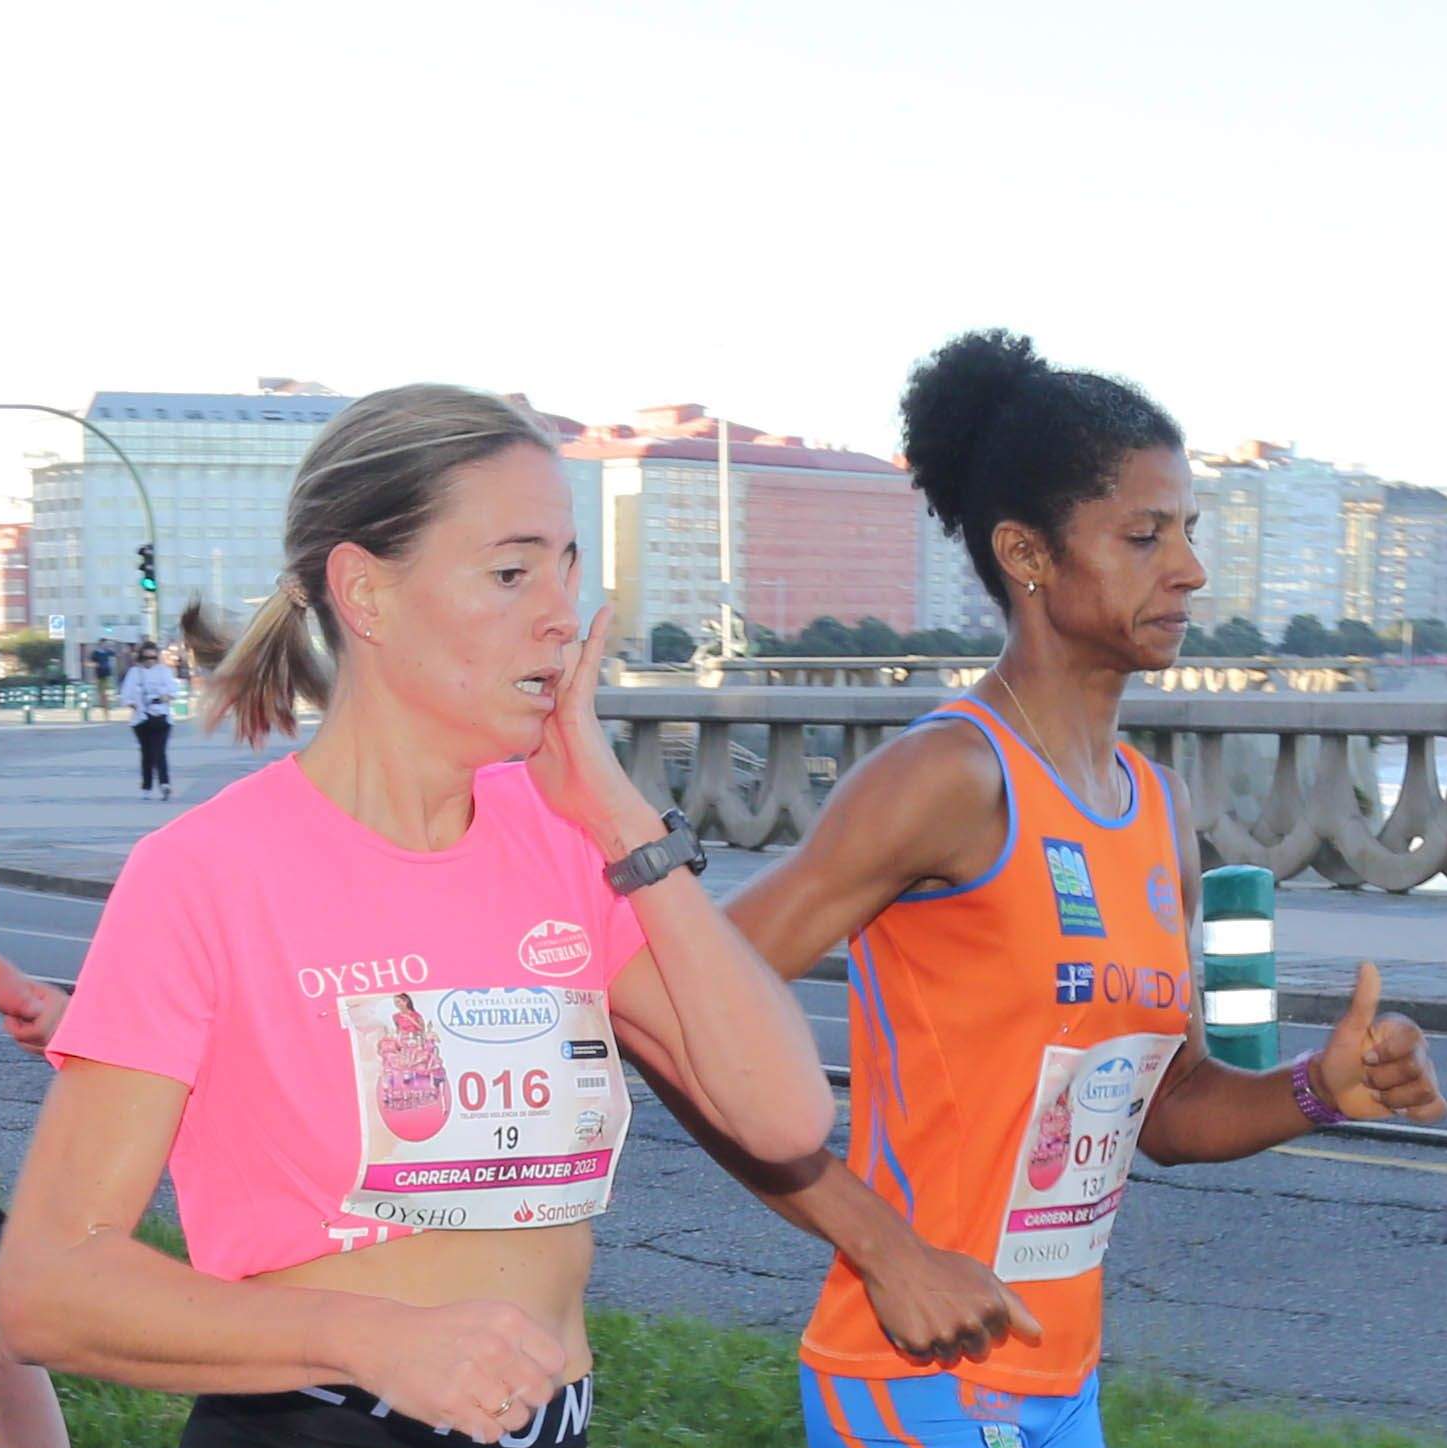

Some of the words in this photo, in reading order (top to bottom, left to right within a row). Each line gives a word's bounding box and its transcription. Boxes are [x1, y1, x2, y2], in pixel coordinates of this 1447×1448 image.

[297, 953, 429, 999] OYSHO
[449, 1001, 553, 1027] ASTURIANA
[458, 1069, 551, 1112] 016
[493, 1126, 519, 1150] 19
[394, 1169, 471, 1187] CARRERA
[474, 1166, 495, 1183] DE
[497, 1164, 518, 1181] LA
[519, 1161, 572, 1179] MUJER
[573, 1157, 598, 1175] 2023
[374, 1201, 467, 1227] OYSHO
[536, 1200, 597, 1222] Santander
